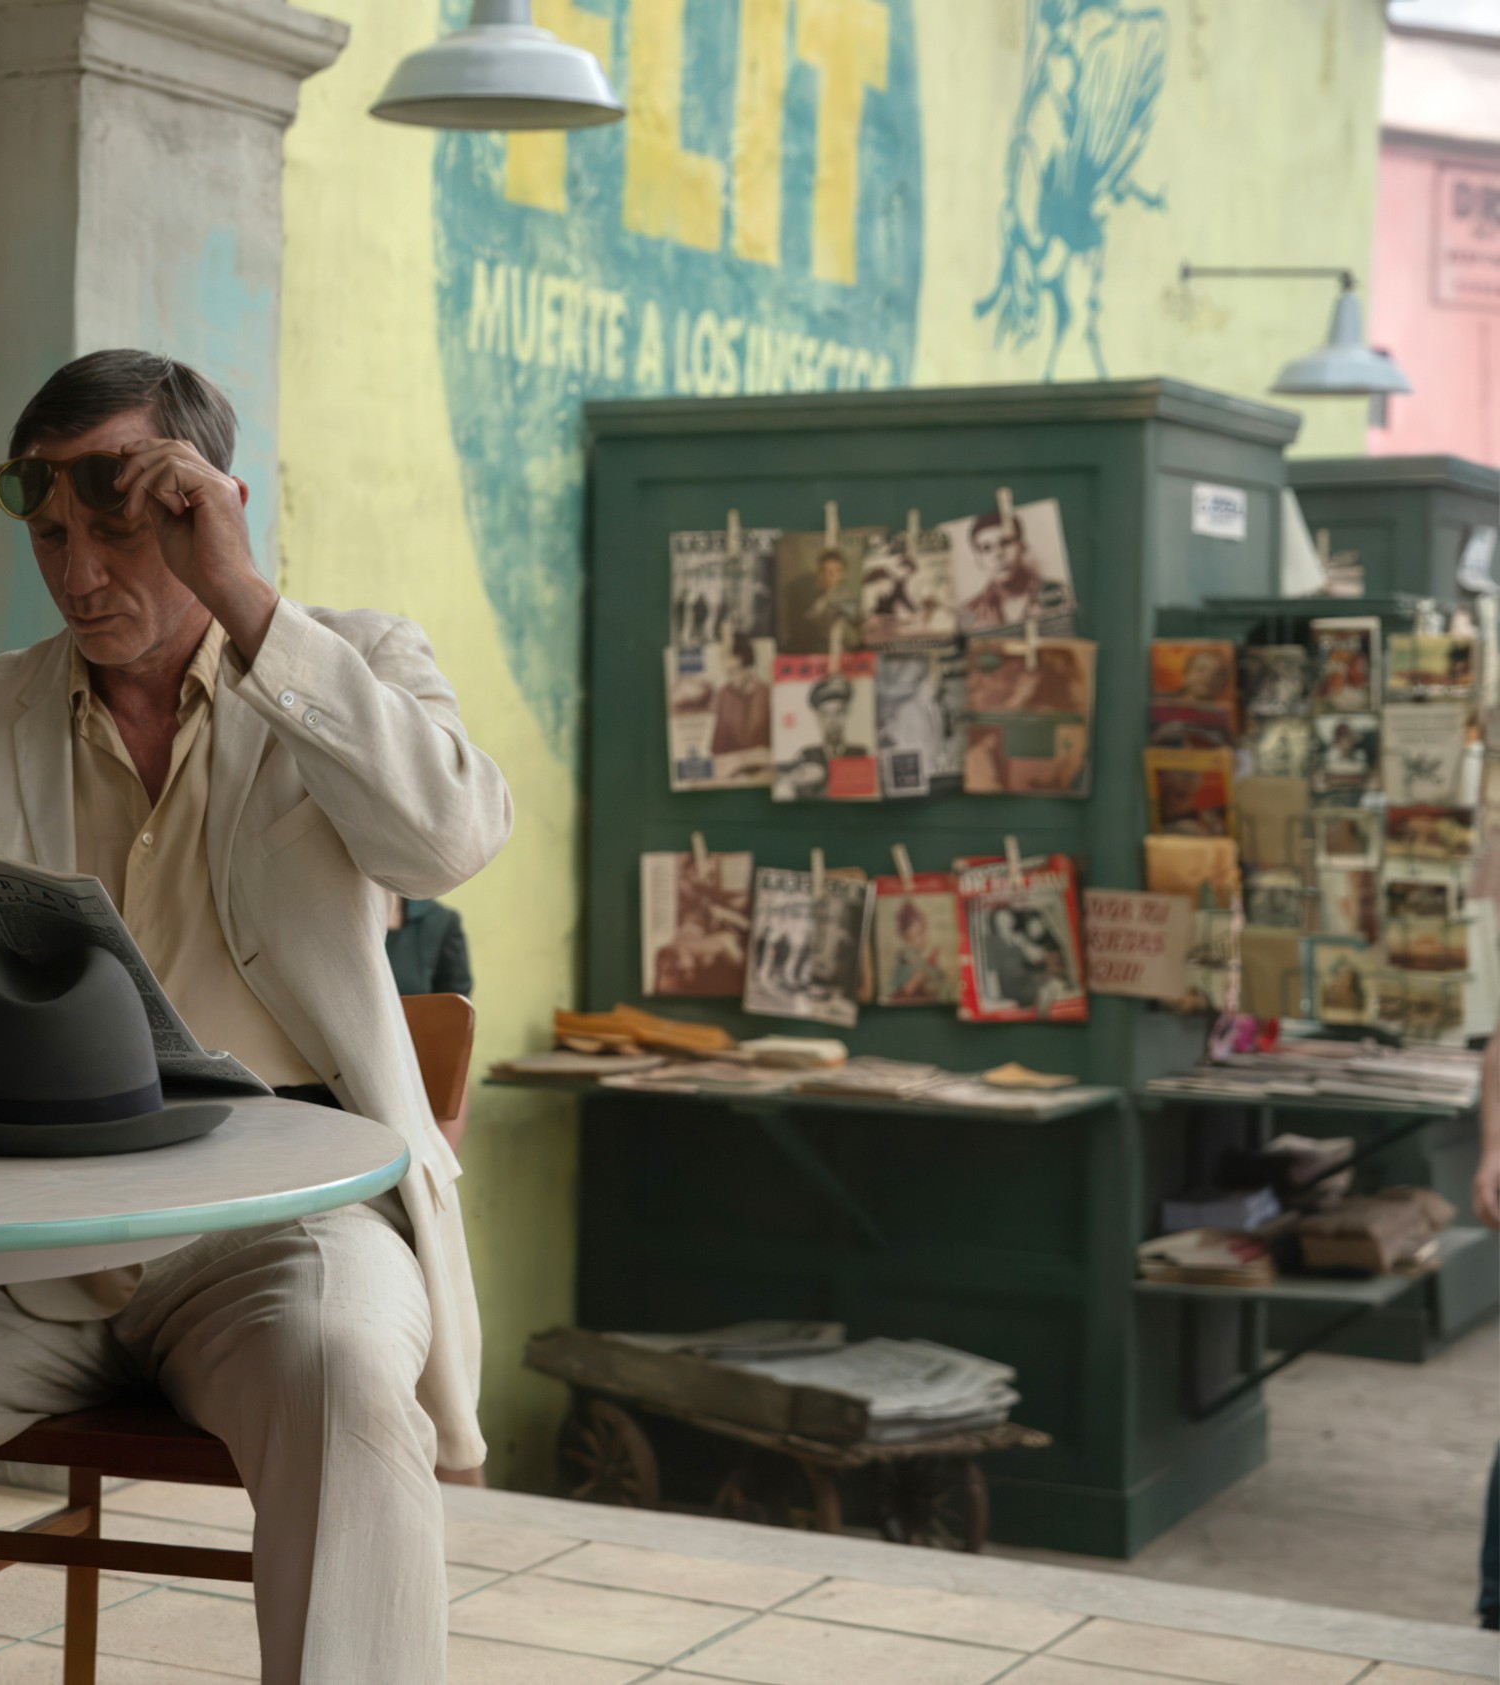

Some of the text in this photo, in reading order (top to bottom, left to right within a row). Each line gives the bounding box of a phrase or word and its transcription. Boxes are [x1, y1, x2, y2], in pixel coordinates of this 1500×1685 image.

[467, 257, 628, 381] MUERTE
[634, 298, 665, 387] A
[674, 307, 745, 398] LOS
